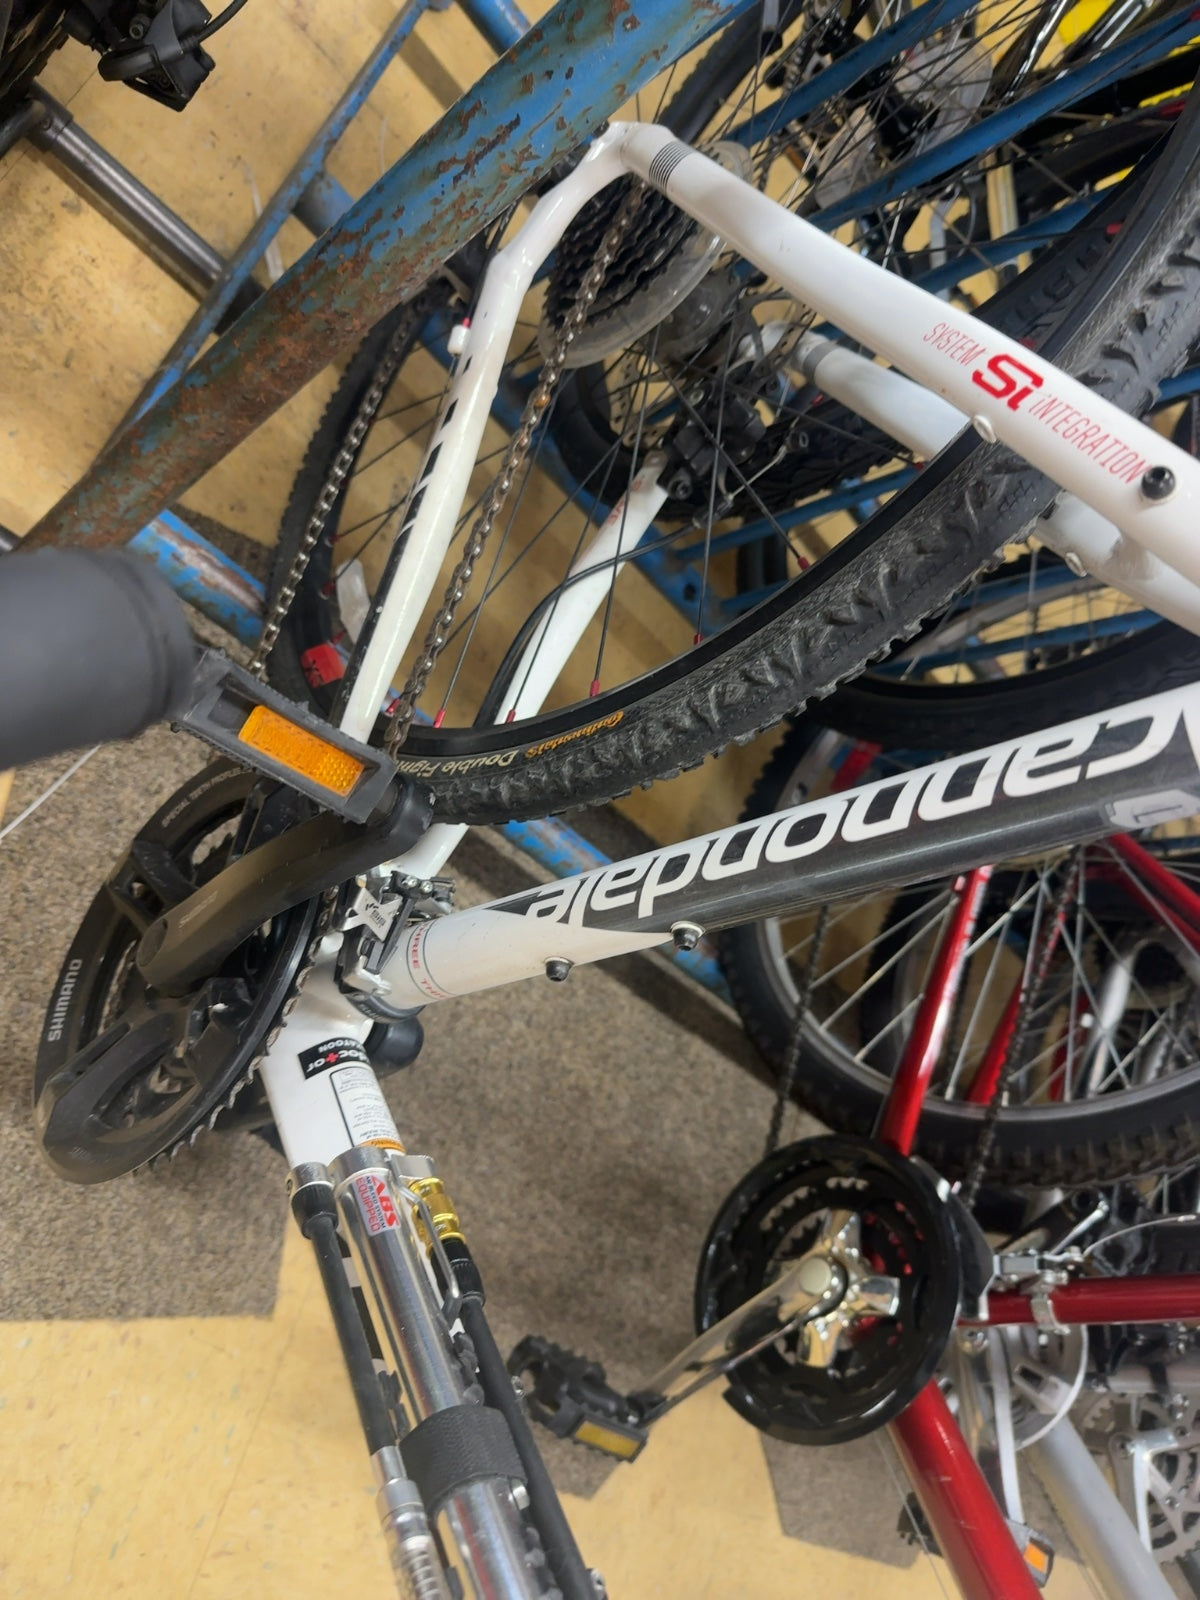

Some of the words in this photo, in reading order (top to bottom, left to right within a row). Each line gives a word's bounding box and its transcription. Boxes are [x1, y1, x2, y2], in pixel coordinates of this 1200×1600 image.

[923, 322, 986, 366] SYSTEM
[397, 760, 435, 777] Figh
[442, 750, 520, 774] Double
[524, 696, 1178, 928] cannondale
[48, 959, 83, 1042] SHIMANO
[355, 1176, 381, 1232] EQUIPPED
[371, 1175, 400, 1227] ABS
